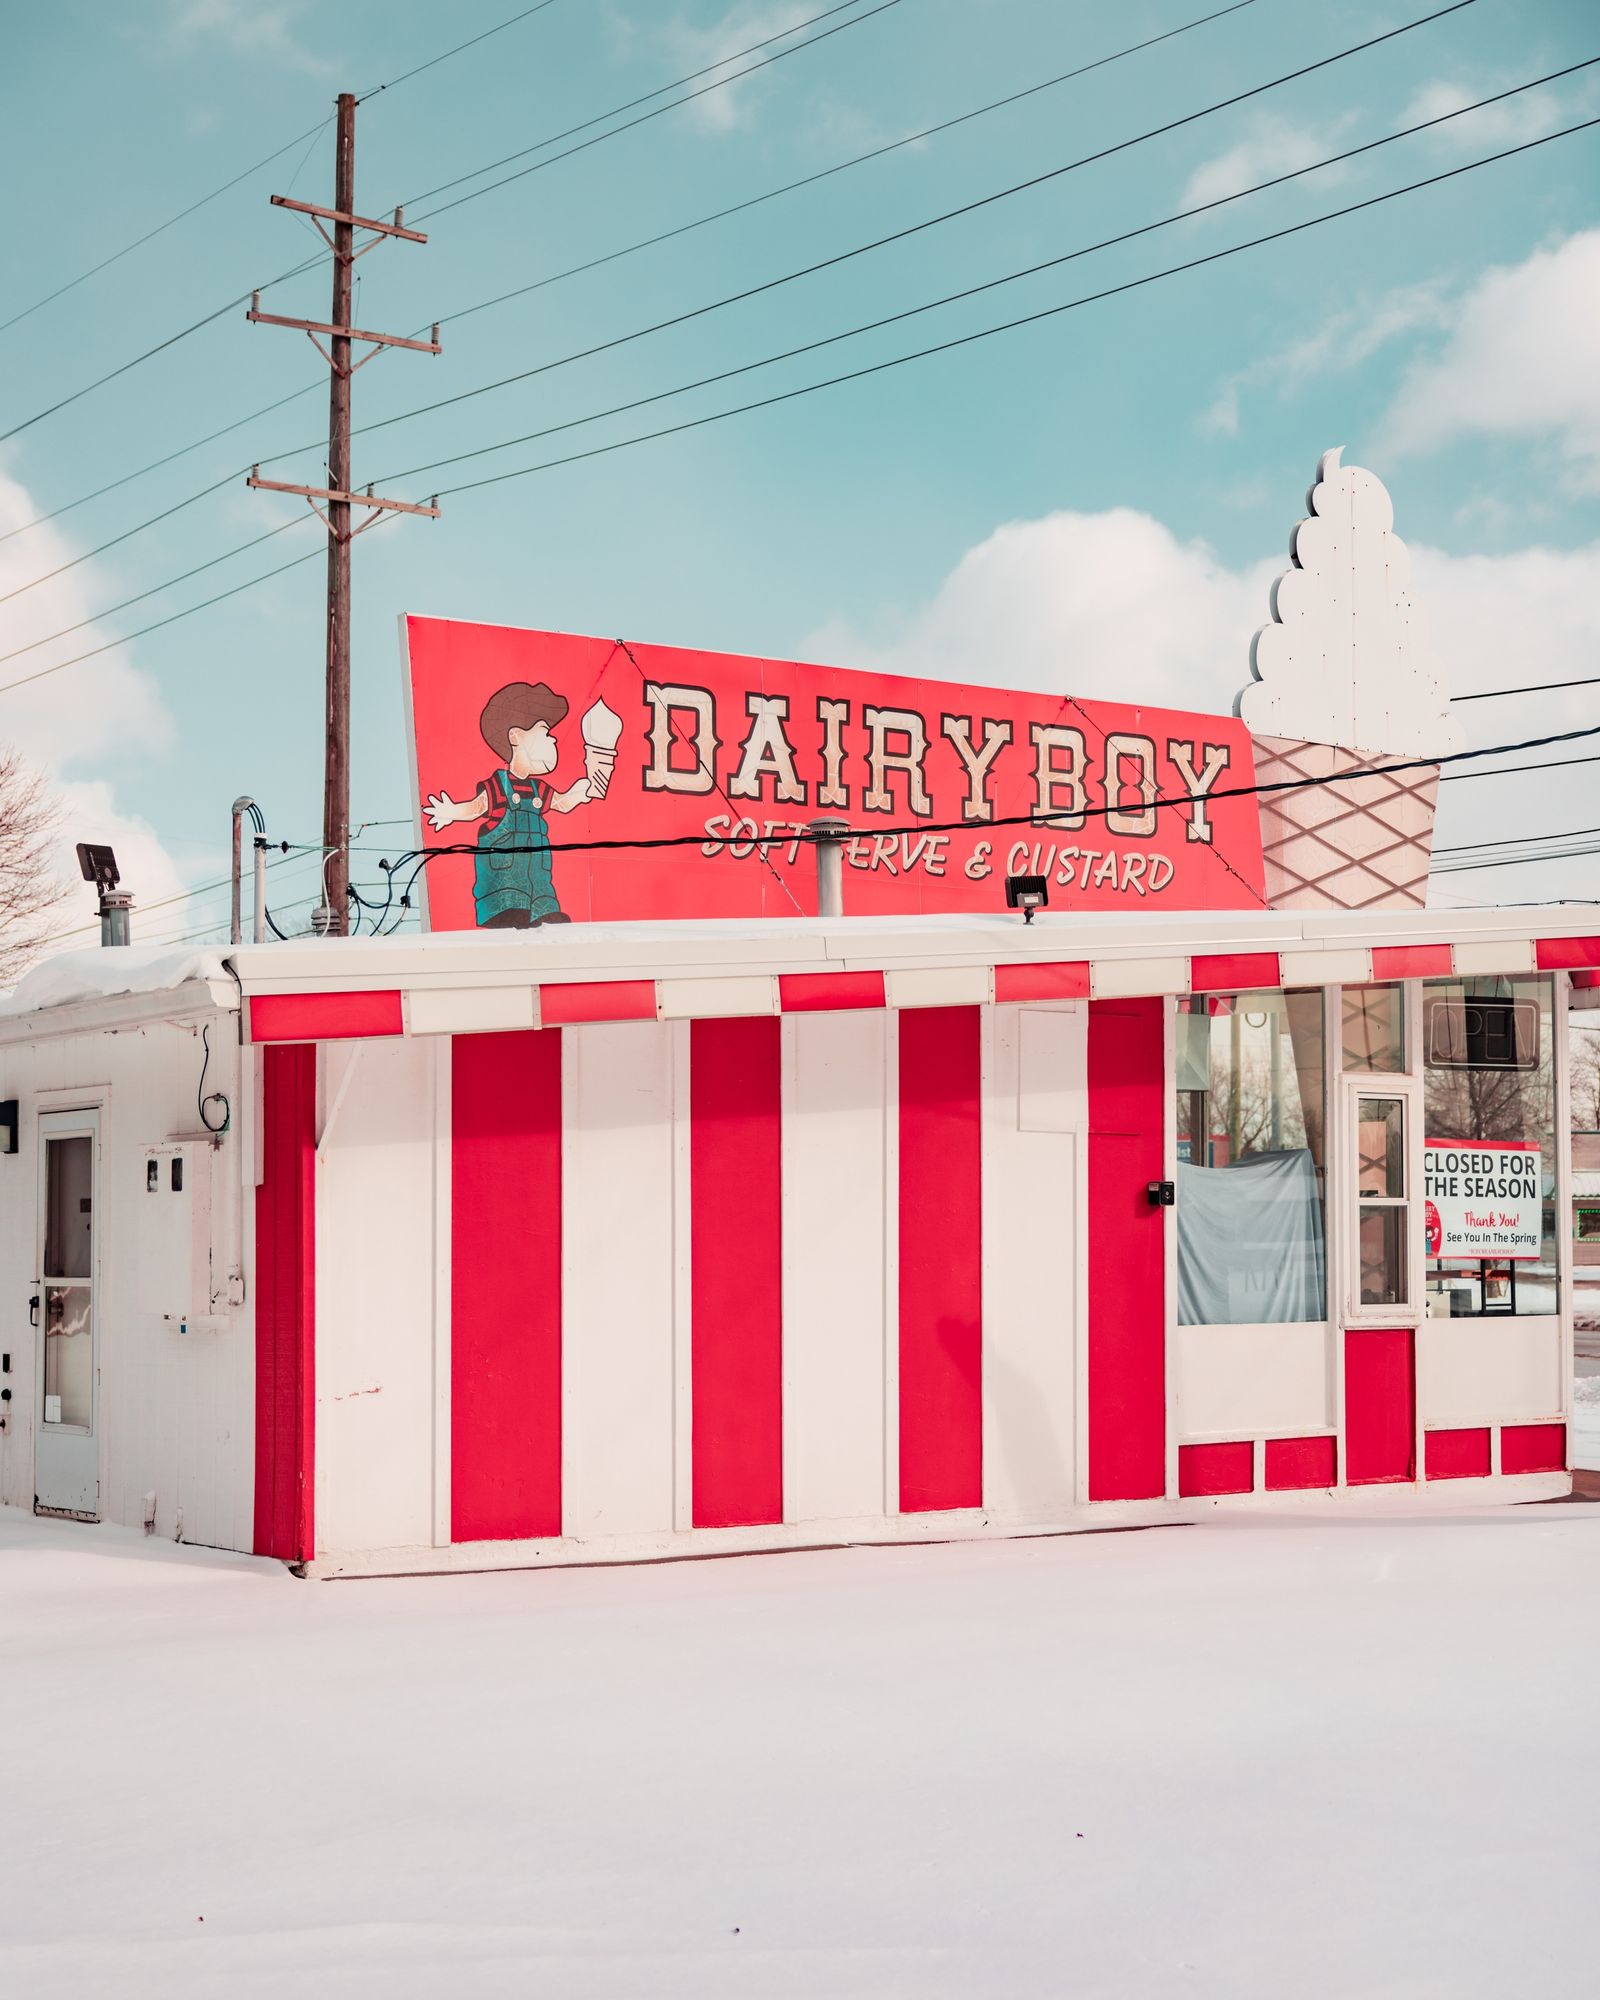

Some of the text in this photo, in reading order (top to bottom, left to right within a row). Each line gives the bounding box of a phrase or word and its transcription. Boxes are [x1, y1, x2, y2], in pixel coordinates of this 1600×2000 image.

[841, 828, 949, 875] ERVE
[965, 841, 993, 878] &
[1006, 841, 1174, 895] CUSTARD
[1424, 1152, 1536, 1175] CLOSED FOR
[1424, 1177, 1536, 1199] THE SEASON
[1464, 1211, 1520, 1228] Thank You!
[1446, 1232, 1537, 1246] See You In The Spring
